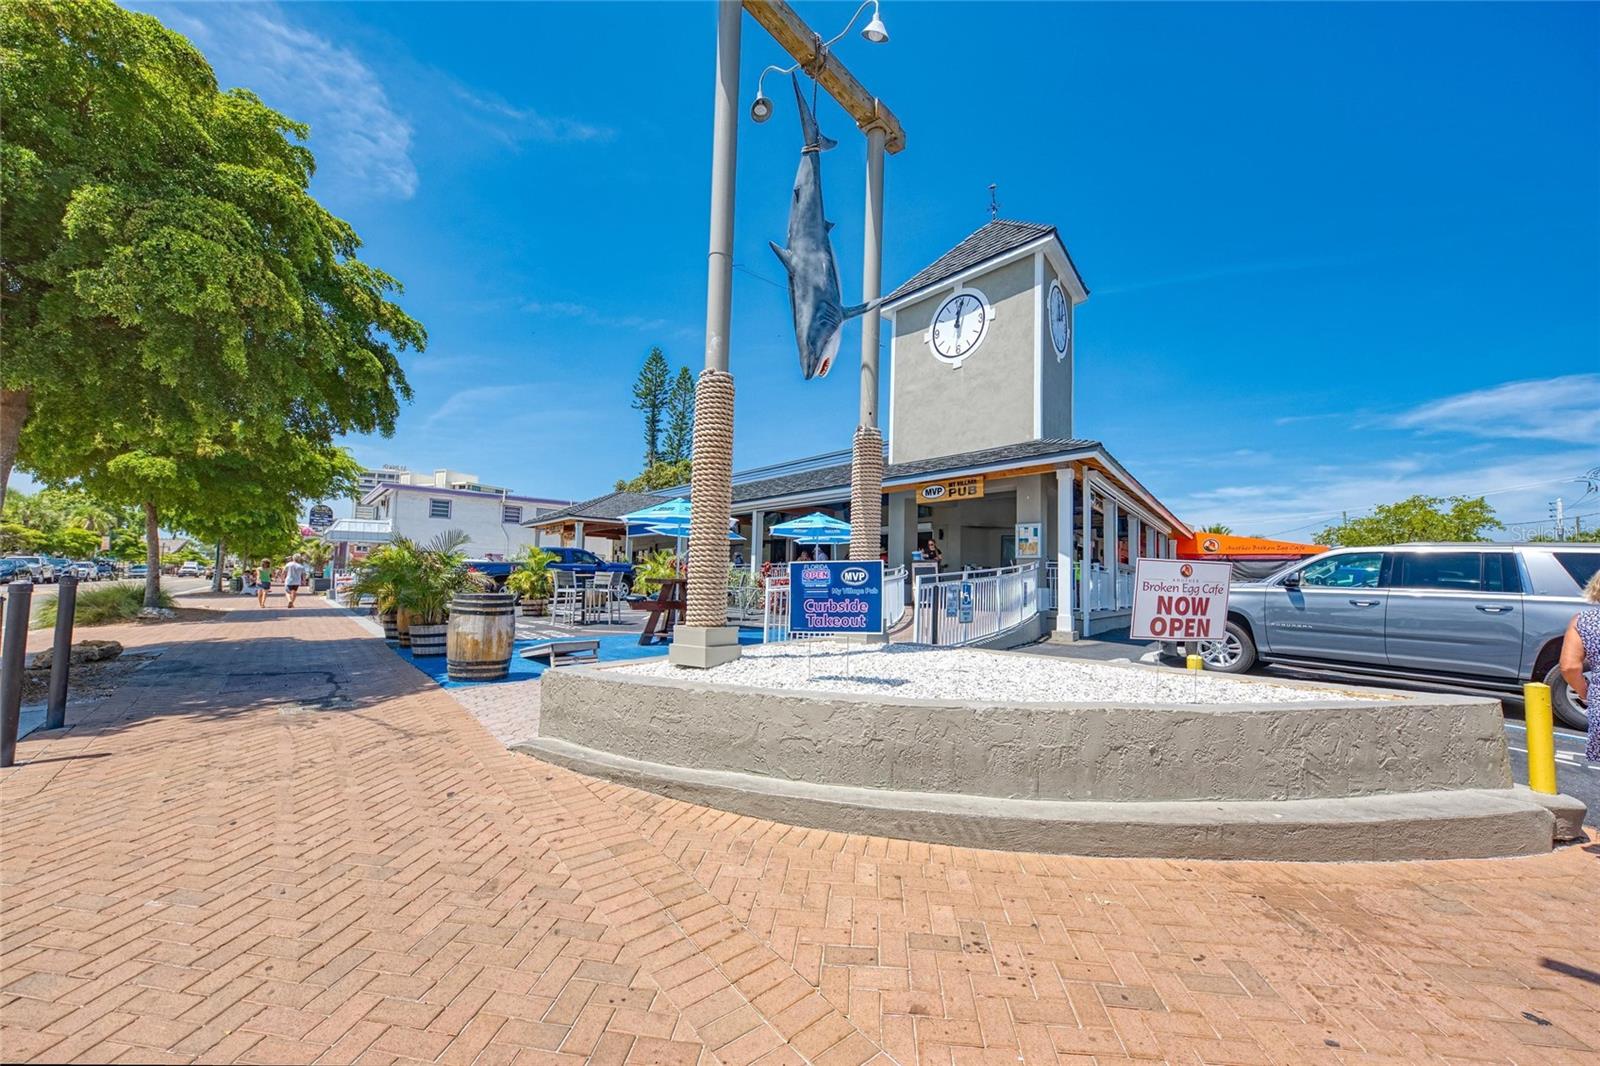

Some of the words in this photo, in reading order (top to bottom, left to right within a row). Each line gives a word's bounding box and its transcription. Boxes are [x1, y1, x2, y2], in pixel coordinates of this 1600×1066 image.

[978, 312, 983, 323] 3
[935, 329, 940, 339] 9
[956, 345, 961, 354] 6
[924, 487, 943, 497] MVP
[948, 485, 977, 497] PUB
[803, 570, 829, 579] OPEN
[844, 572, 865, 581] MVP
[842, 587, 864, 596] Village
[865, 587, 879, 595] Pub
[1143, 581, 1180, 593] Broken
[1182, 583, 1200, 596] Egg
[804, 599, 869, 613] Curbside
[1156, 595, 1210, 616] NOW
[806, 613, 867, 628] Takeout
[1149, 616, 1211, 637] OPEN
